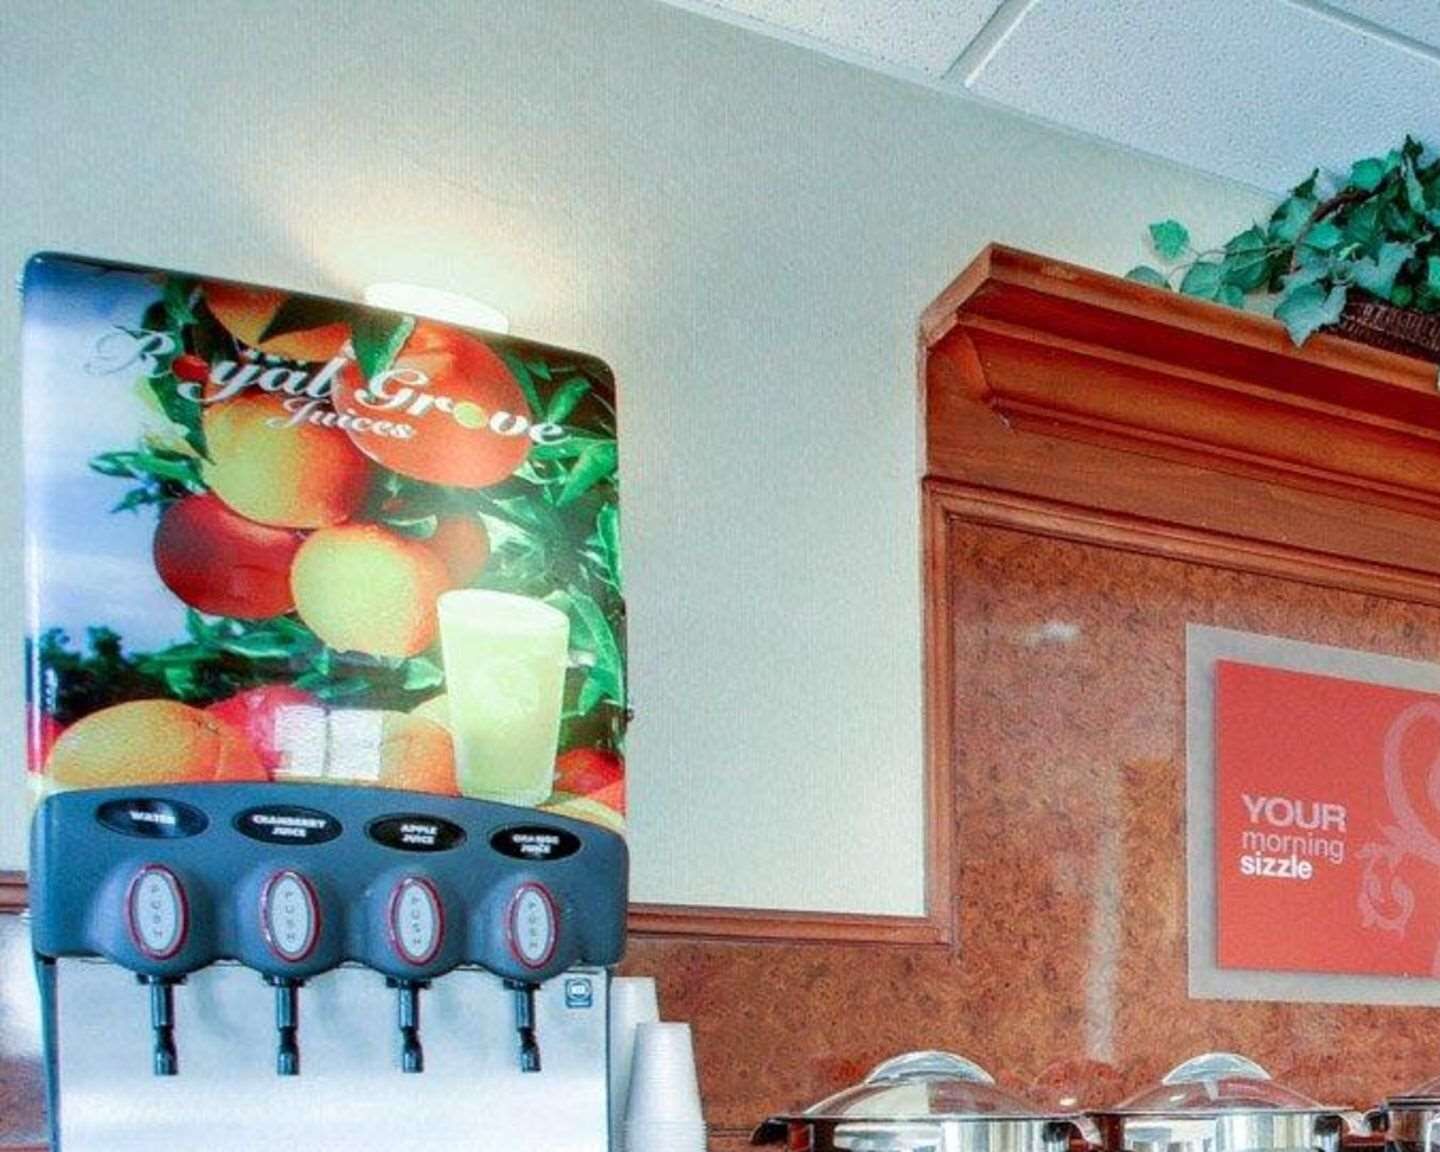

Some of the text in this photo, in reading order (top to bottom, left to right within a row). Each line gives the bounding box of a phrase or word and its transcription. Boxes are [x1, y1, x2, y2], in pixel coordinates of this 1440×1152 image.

[354, 367, 572, 445] Grove
[264, 397, 413, 439] Juices
[128, 809, 177, 826] WATER
[1241, 794, 1347, 832] YOUR
[271, 826, 307, 838] JUICE
[400, 823, 438, 836] APPLE
[401, 833, 435, 845] JUICE
[512, 833, 560, 846] ORANGE
[1242, 831, 1344, 864] morning
[1240, 851, 1313, 880] sizzle
